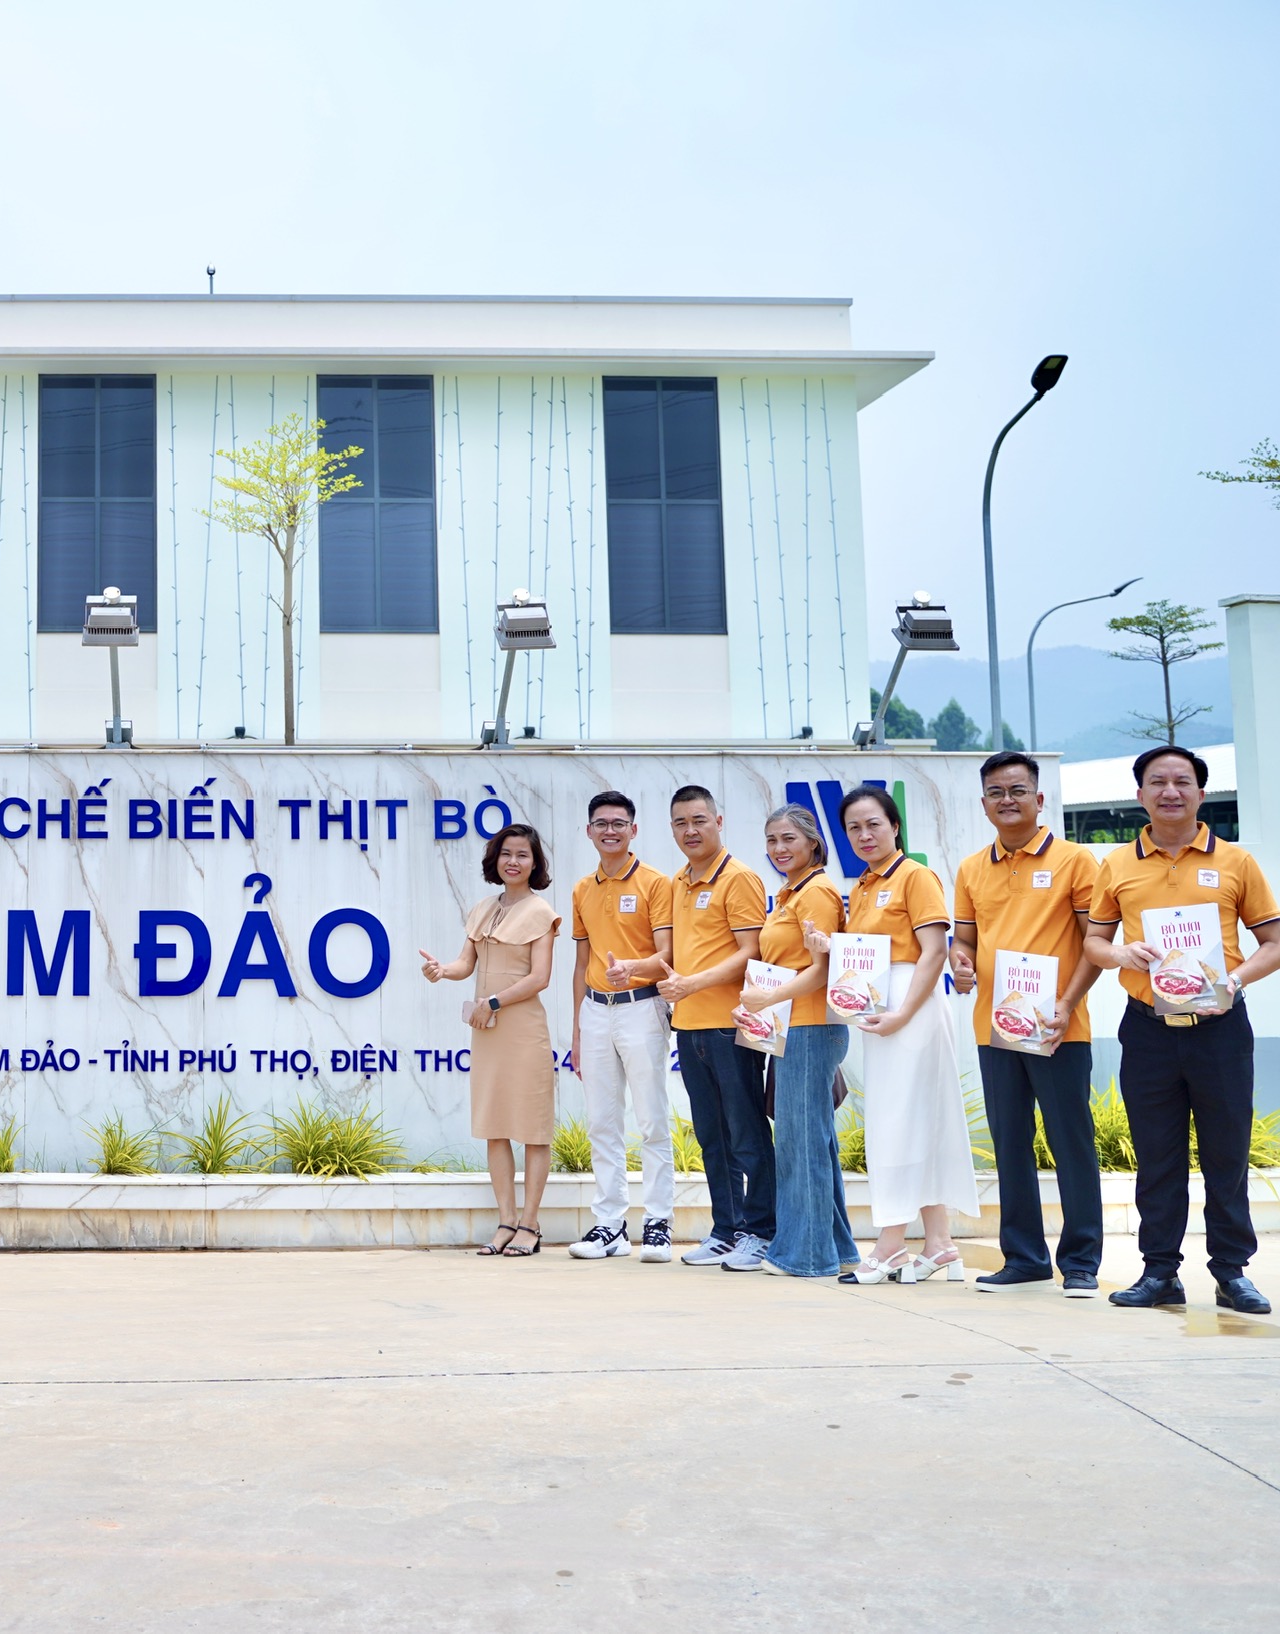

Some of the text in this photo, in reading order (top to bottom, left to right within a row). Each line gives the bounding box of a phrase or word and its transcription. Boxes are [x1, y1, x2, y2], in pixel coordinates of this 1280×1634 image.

[128, 777, 255, 840] BIẾN
[278, 799, 409, 852] THỊT
[433, 784, 513, 841] BÒ
[133, 872, 391, 998] ĐẢO
[20, 1039, 81, 1072] ĐẢO
[104, 1039, 169, 1073] TỈNH
[179, 1043, 237, 1073] PHÚ
[250, 1049, 320, 1080] THỌ,
[330, 1043, 398, 1080] ĐIỆN
